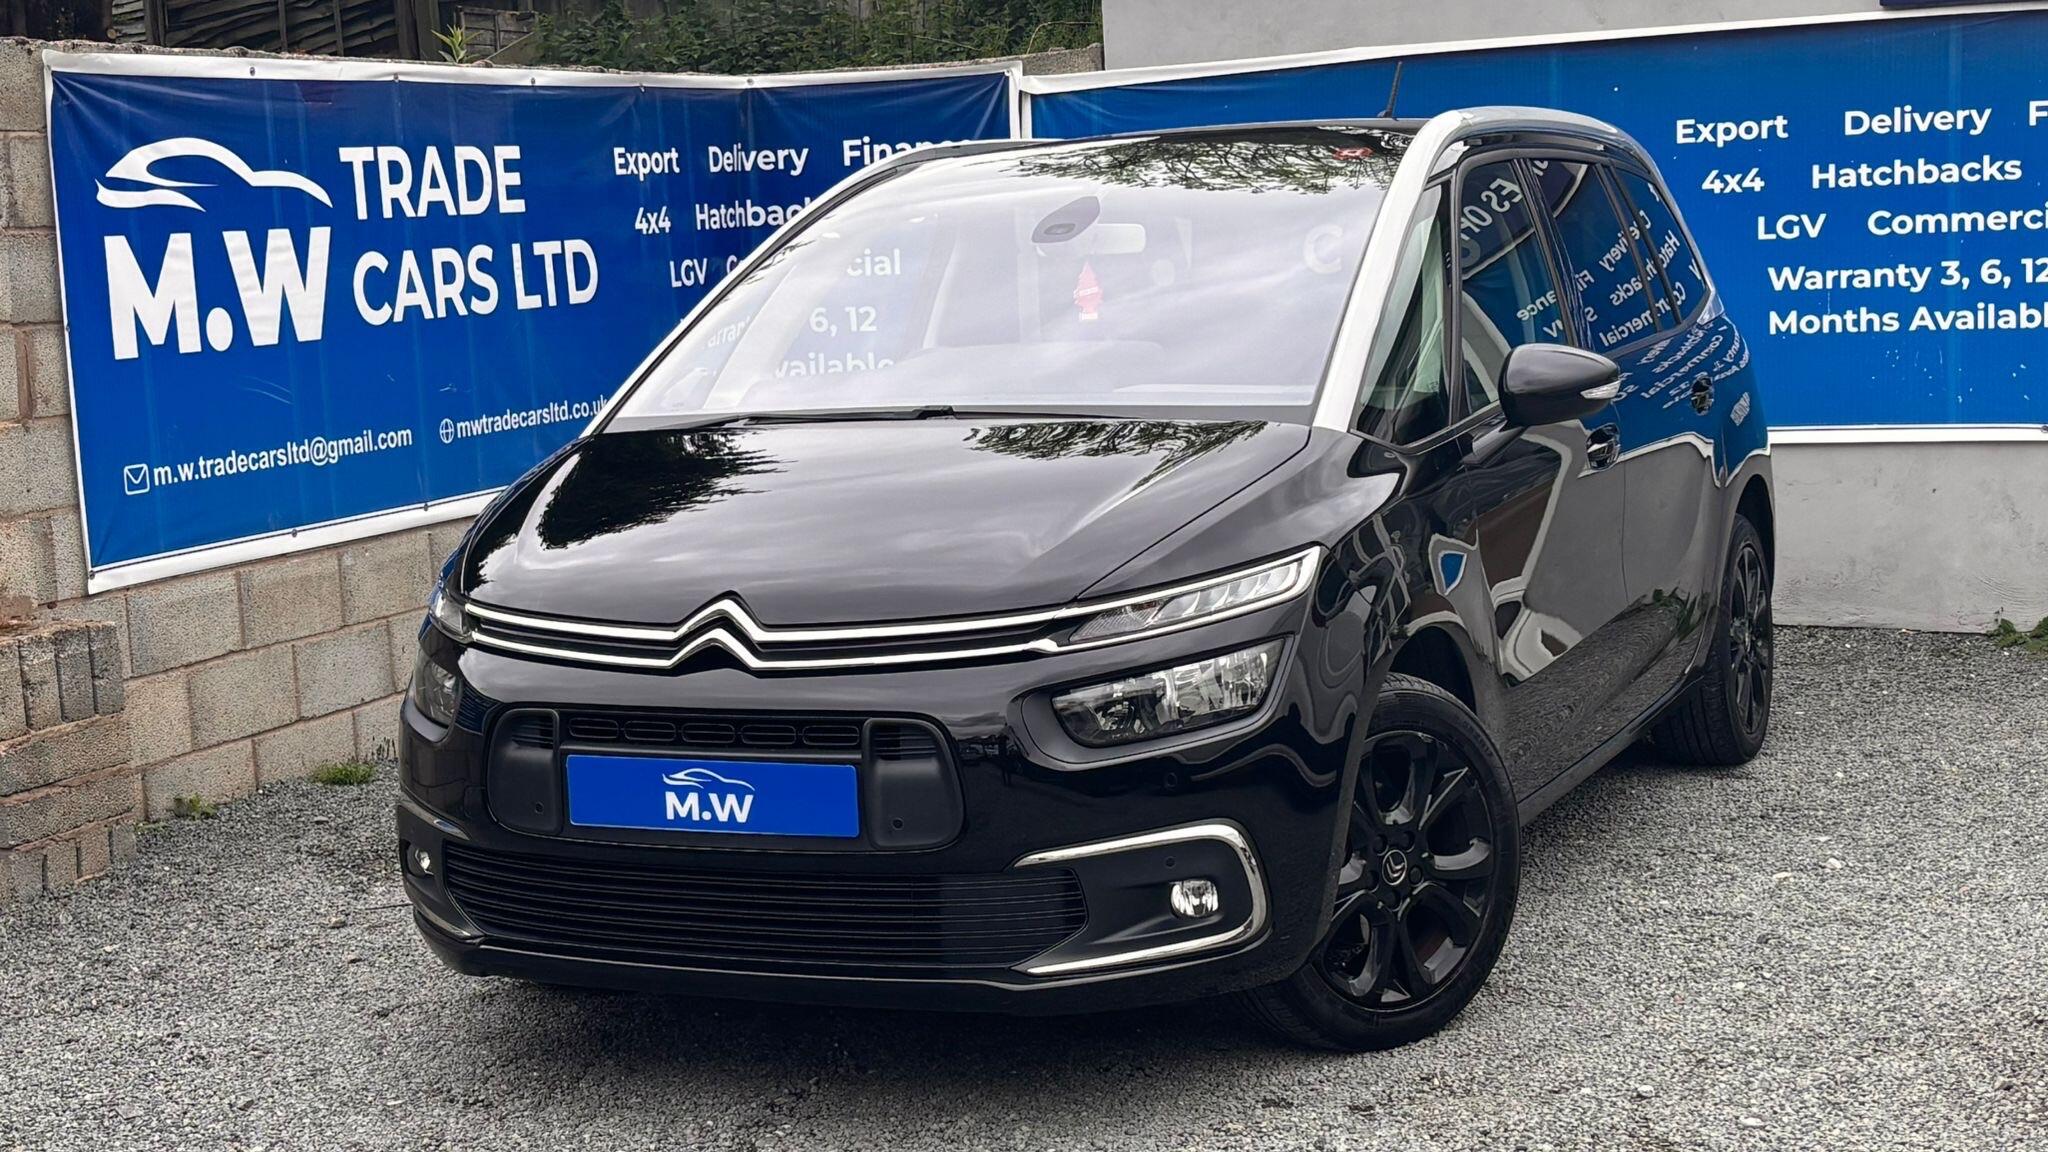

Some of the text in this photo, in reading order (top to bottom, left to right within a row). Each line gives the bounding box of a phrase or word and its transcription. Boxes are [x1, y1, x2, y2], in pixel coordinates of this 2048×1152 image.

[1676, 115, 1789, 148] Export
[1844, 104, 1992, 136] Delivery
[613, 147, 680, 182] Export
[708, 142, 809, 176] Delivery
[1701, 154, 2023, 194] 4x4 Hatchbacks
[338, 145, 526, 220] TRADE
[634, 206, 671, 234] 4x4
[1757, 201, 2048, 240] LGV Commerci
[353, 239, 598, 326] CARS LTD
[669, 257, 708, 288] LGV
[1767, 263, 1932, 293] Warranty
[1940, 260, 1970, 290] 3,
[1980, 258, 2011, 289] 6,
[103, 226, 331, 360] M.W
[808, 306, 838, 337] 6,
[845, 306, 877, 332] 12
[1769, 301, 2048, 335] Months Availabl
[153, 429, 412, 486] m.w.tradecarsltd@gmail.com
[665, 791, 754, 823] M.W
